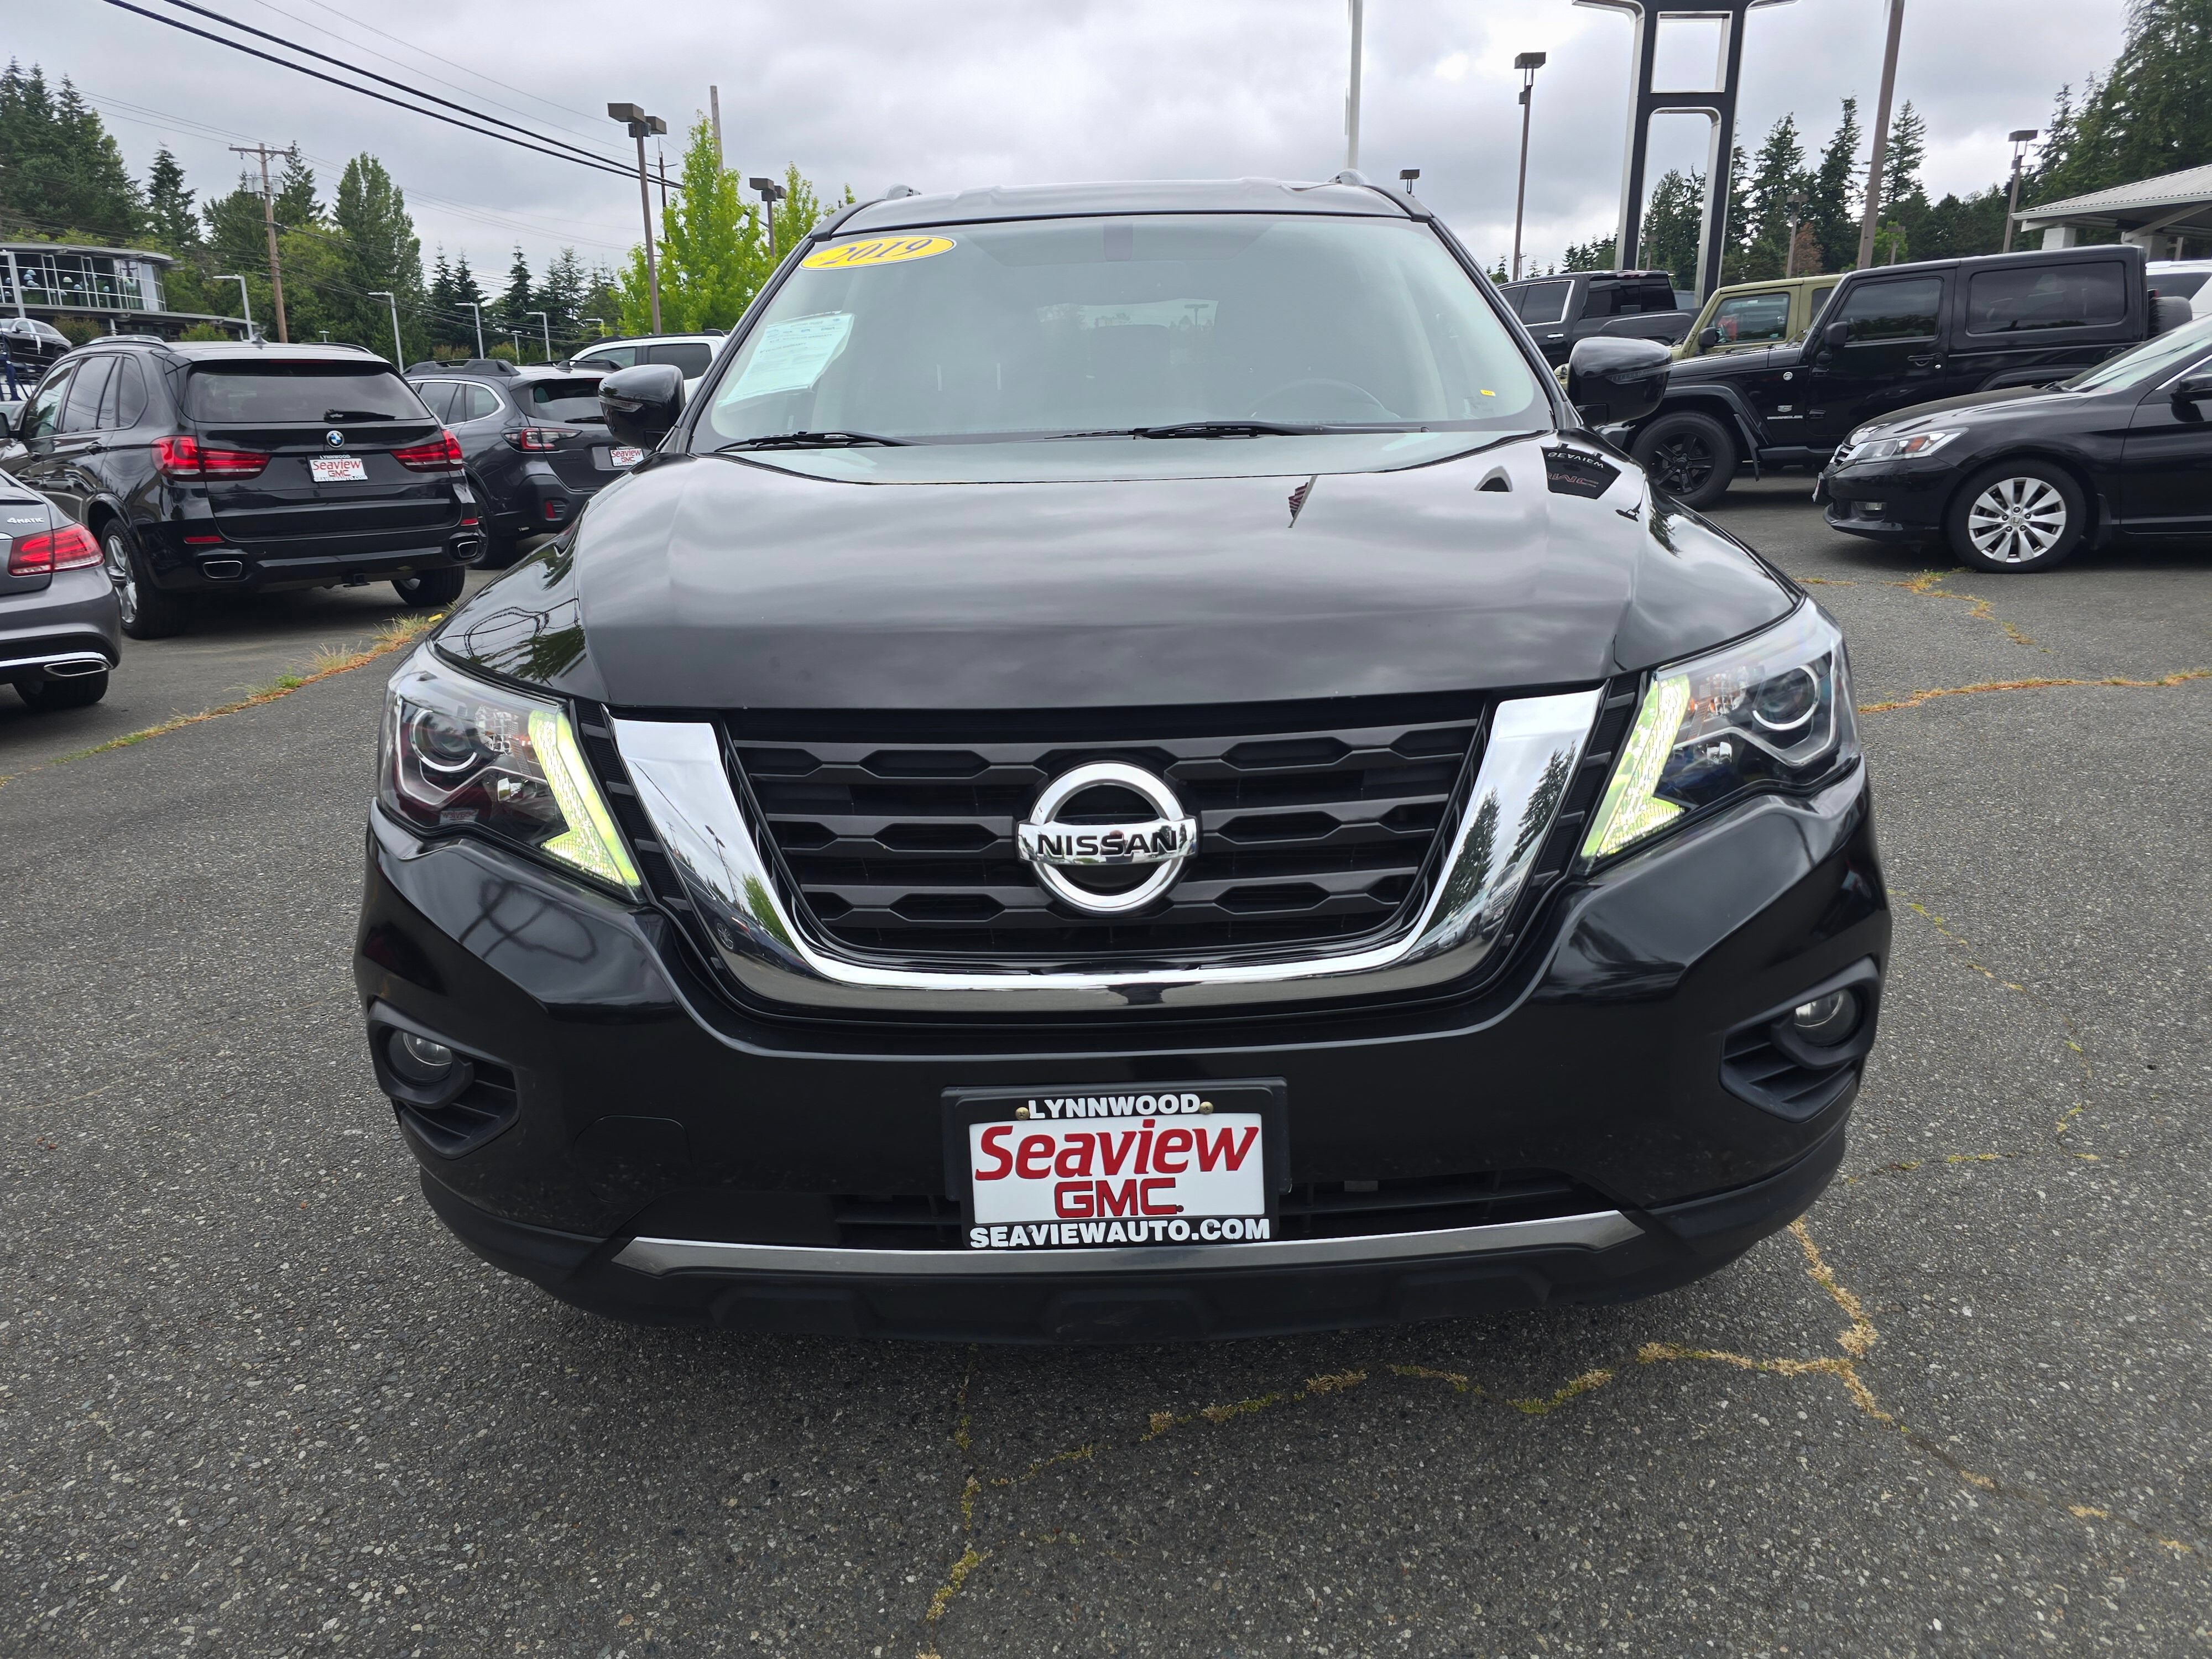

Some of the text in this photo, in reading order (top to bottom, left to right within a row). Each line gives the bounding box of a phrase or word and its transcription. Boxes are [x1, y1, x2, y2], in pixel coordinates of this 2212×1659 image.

[817, 238, 933, 267] 2019
[313, 460, 361, 470] Seaview
[612, 448, 641, 458] Seaview
[1037, 830, 1177, 857] NISSAN
[1029, 1094, 1201, 1120] LYNNWOOD
[974, 1119, 1259, 1181] Seaview
[1054, 1178, 1184, 1218] GMC
[970, 1218, 1270, 1249] SEAVIEWAUTO.COM
